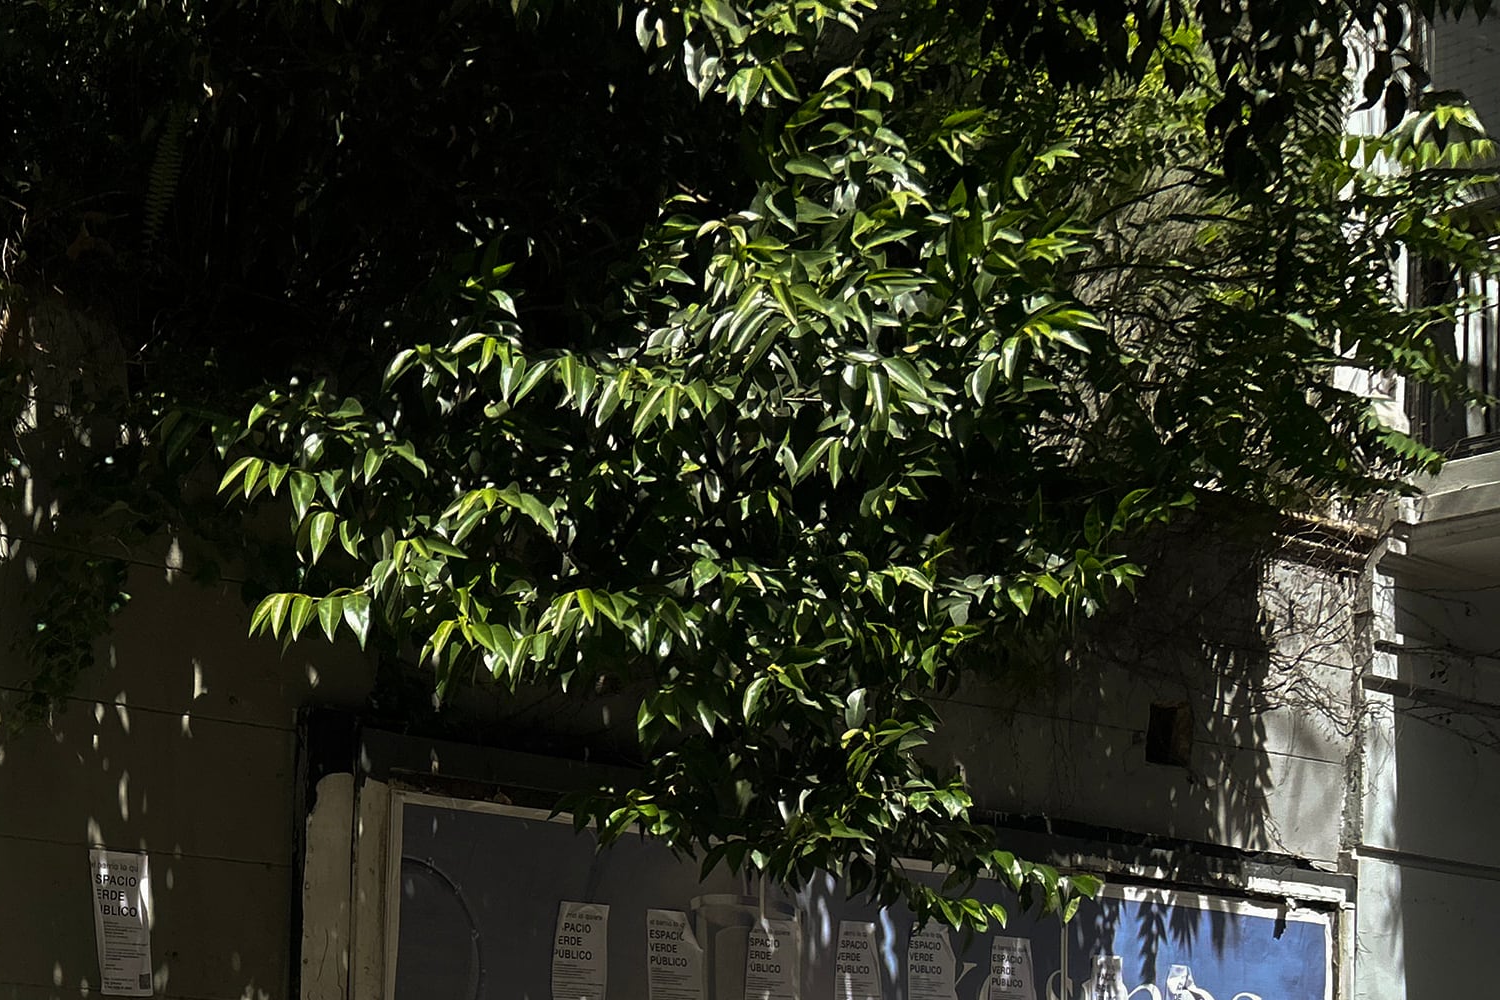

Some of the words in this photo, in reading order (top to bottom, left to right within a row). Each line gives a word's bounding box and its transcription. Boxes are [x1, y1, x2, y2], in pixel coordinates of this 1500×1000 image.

[95, 873, 137, 887] SPACIO
[100, 904, 138, 917] BLICO
[562, 922, 592, 933] PACIO
[558, 936, 583, 946] ERDE
[749, 937, 780, 948] SPACIO
[840, 940, 868, 950] SPACIO
[909, 940, 941, 951] ESPACIO
[649, 943, 678, 953] VERDE
[749, 950, 772, 960] ERDE
[909, 952, 934, 962] VERDE
[992, 966, 1016, 976] VERDE
